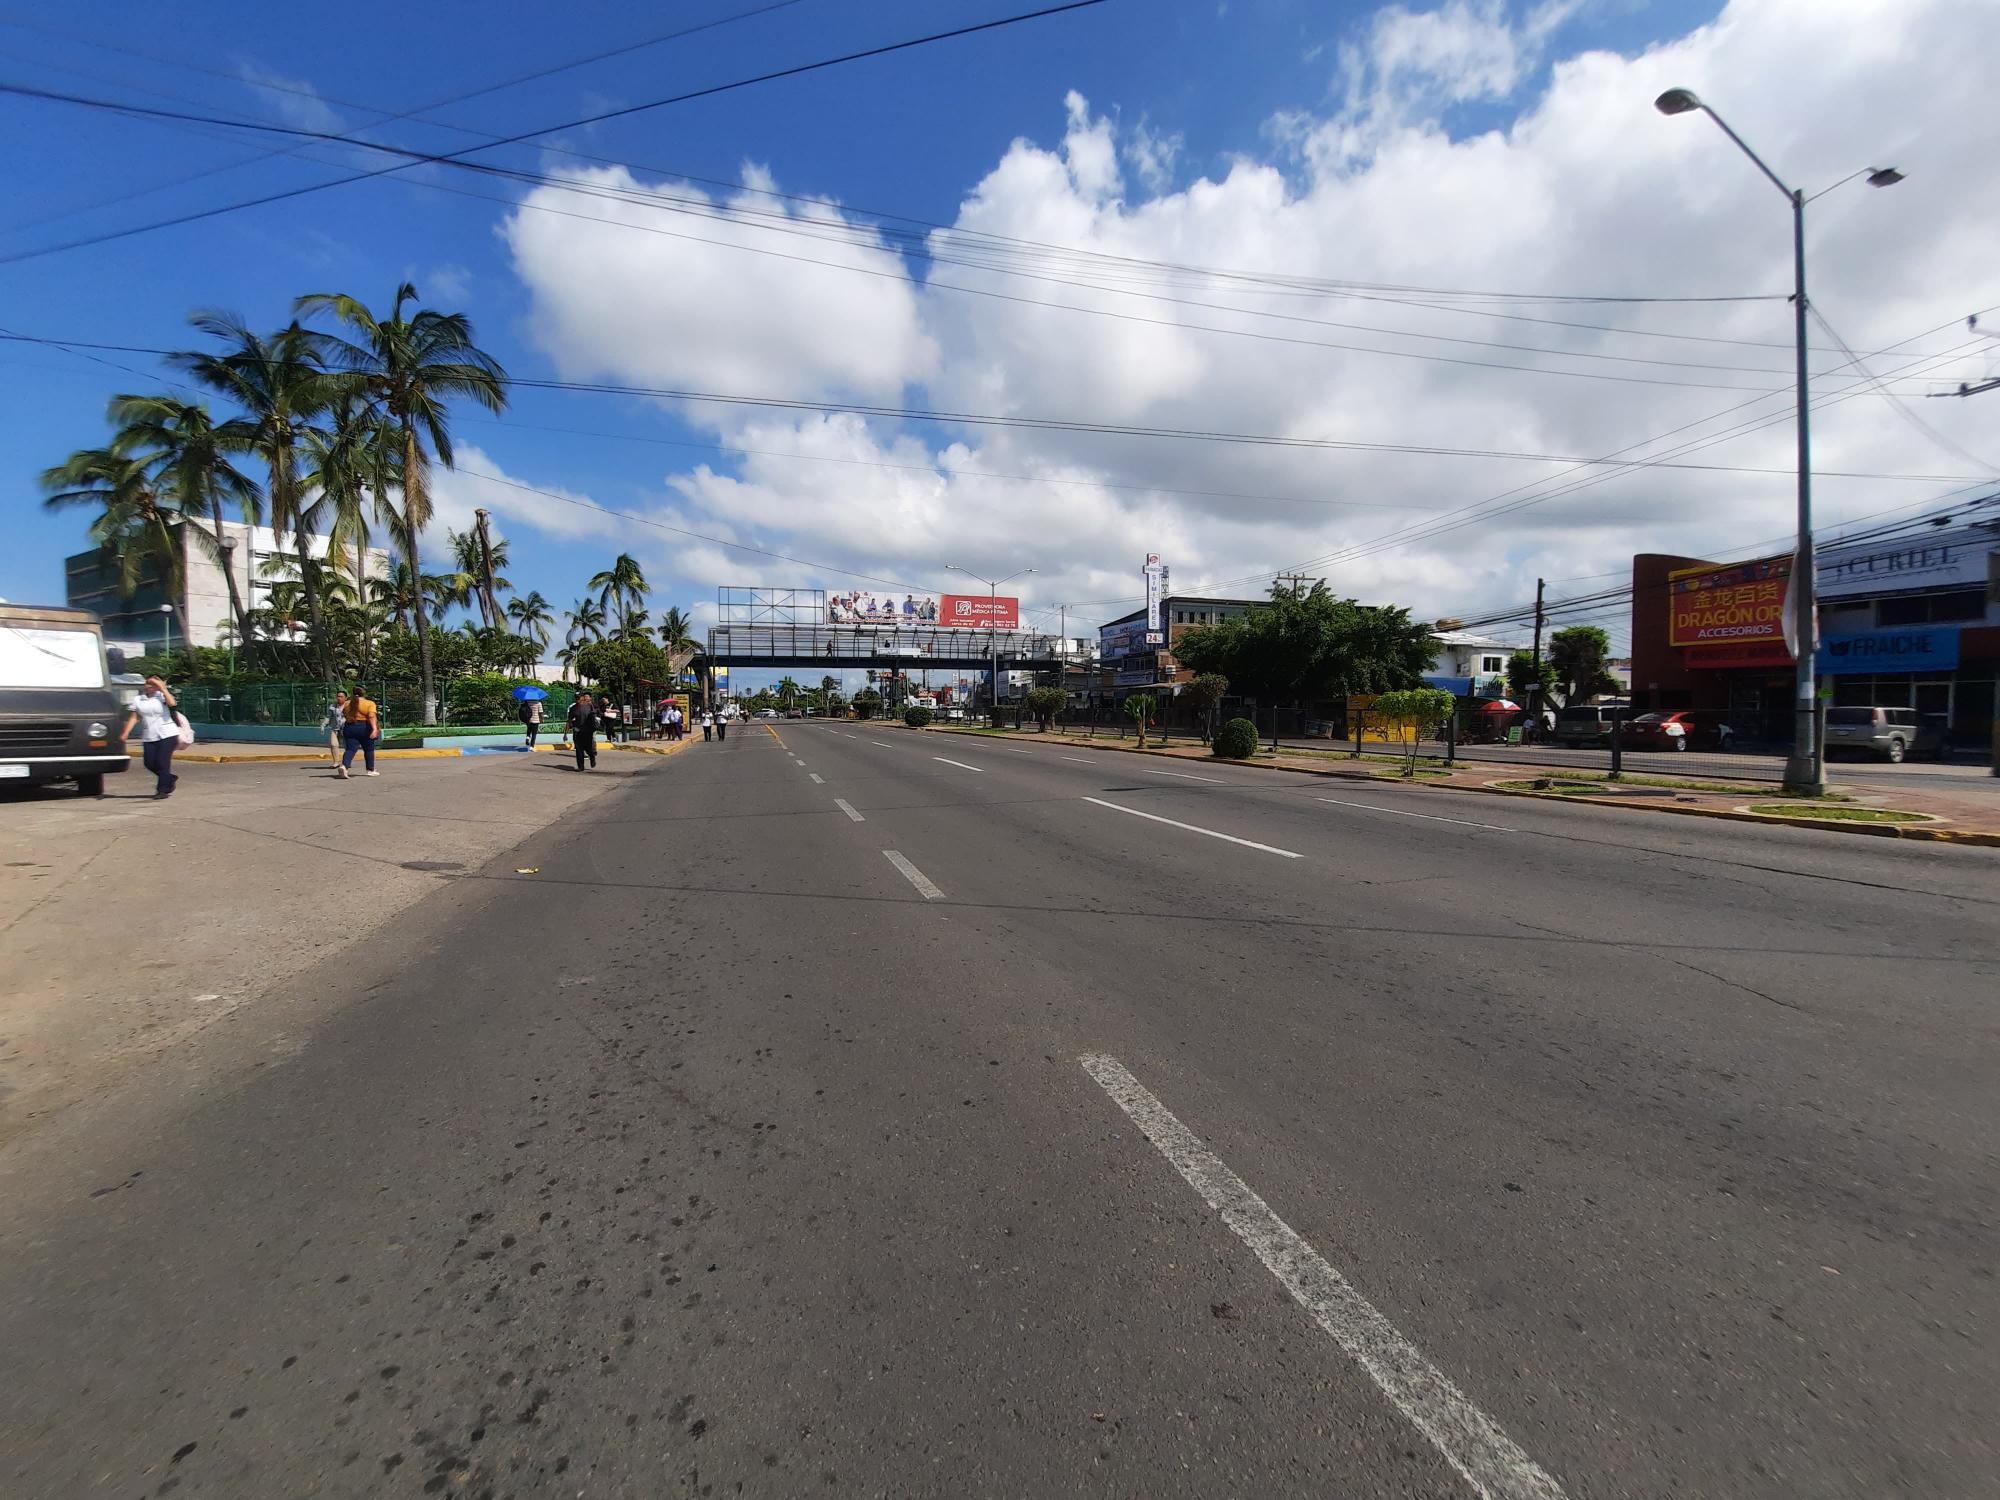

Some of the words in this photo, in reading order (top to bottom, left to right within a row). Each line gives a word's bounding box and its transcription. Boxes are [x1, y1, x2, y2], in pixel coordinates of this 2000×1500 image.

[1693, 582, 1779, 609] 金龙百货
[1678, 605, 1753, 628] DRAGÓN
[1755, 605, 1783, 622] OR
[1147, 634, 1157, 642] 24
[1697, 624, 1774, 639] ACCESORIOS
[1852, 634, 1935, 656] FRAICHE
